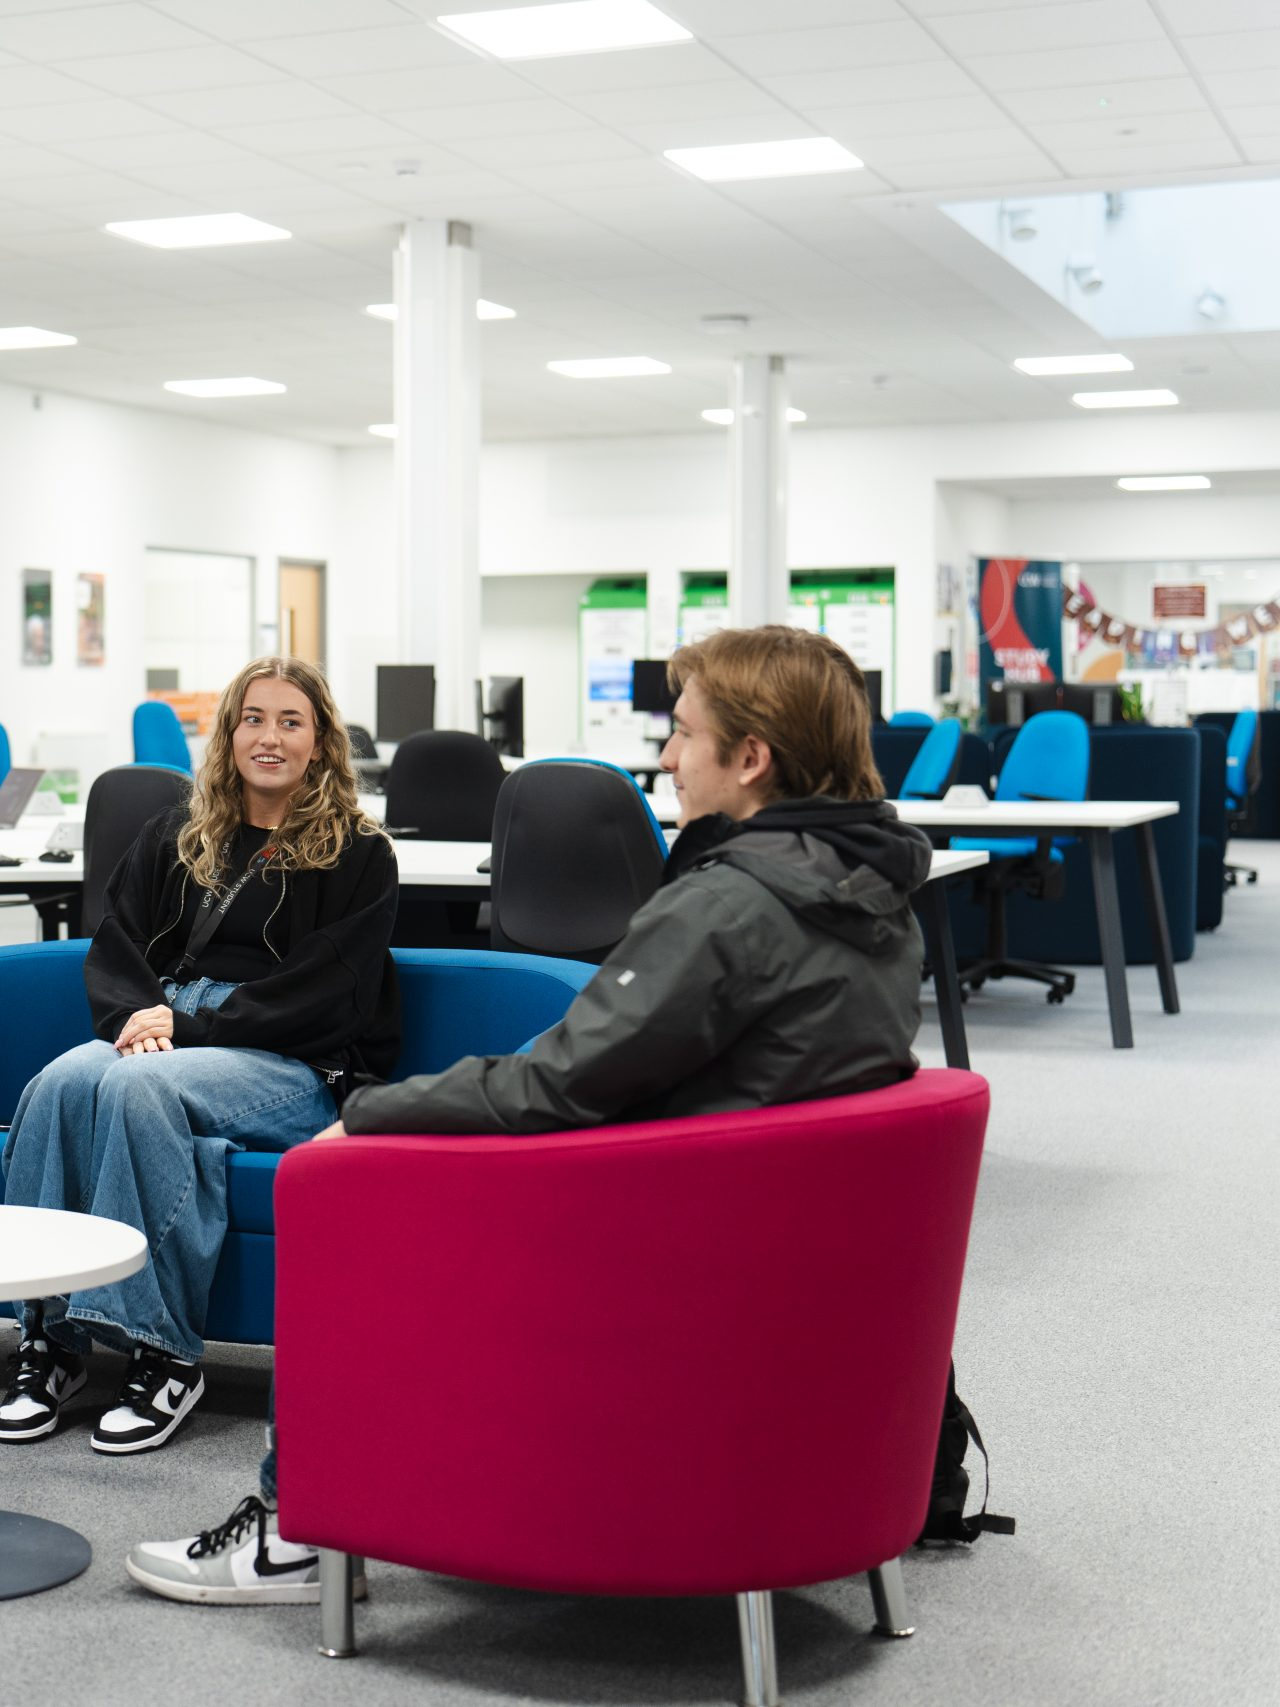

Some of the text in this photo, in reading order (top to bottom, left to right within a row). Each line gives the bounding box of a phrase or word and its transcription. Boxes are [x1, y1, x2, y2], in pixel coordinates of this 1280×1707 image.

[994, 648, 1050, 667] STUDY
[201, 889, 213, 908] UCW
[218, 868, 256, 914] UCW STUDENT
